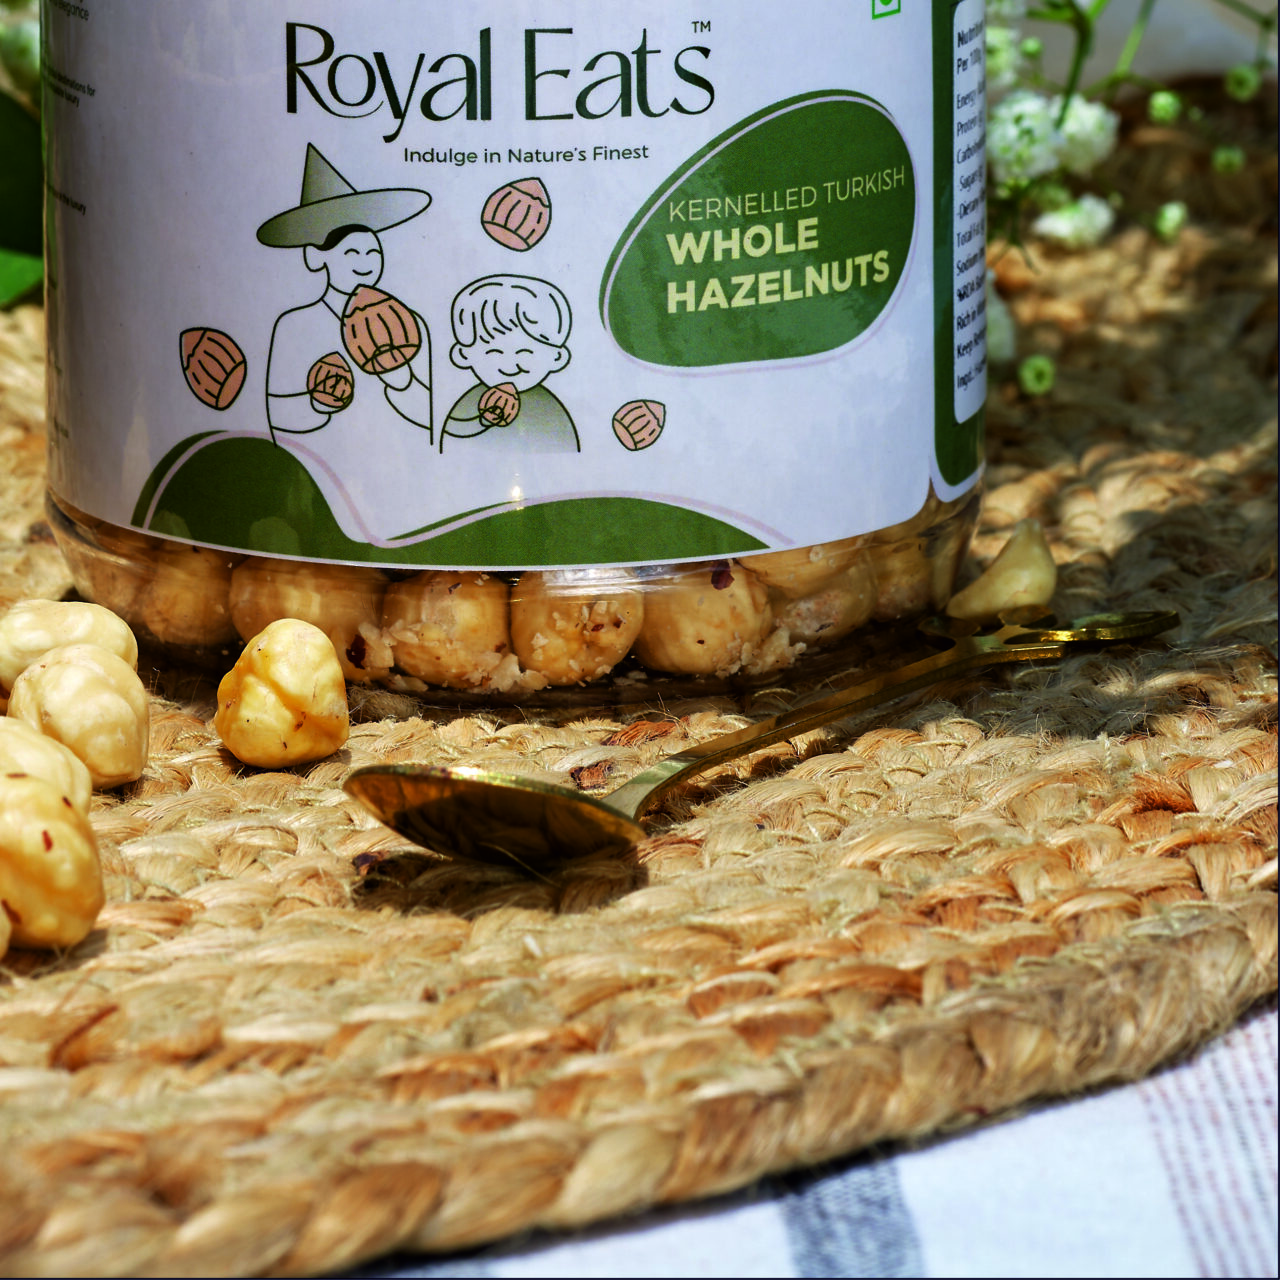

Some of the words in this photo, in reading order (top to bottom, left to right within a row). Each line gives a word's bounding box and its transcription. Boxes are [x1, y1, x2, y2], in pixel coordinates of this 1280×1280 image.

[285, 21, 492, 144] Royal
[524, 27, 715, 121] Eats
[404, 148, 478, 167] Indulge
[484, 149, 501, 163] in
[508, 147, 587, 163] Nature's
[593, 145, 649, 161] Finest
[669, 185, 818, 223] KERNELLED
[822, 165, 906, 204] TURKISH
[665, 217, 819, 266] WHOLE
[666, 250, 890, 314] HAZELNUTS
